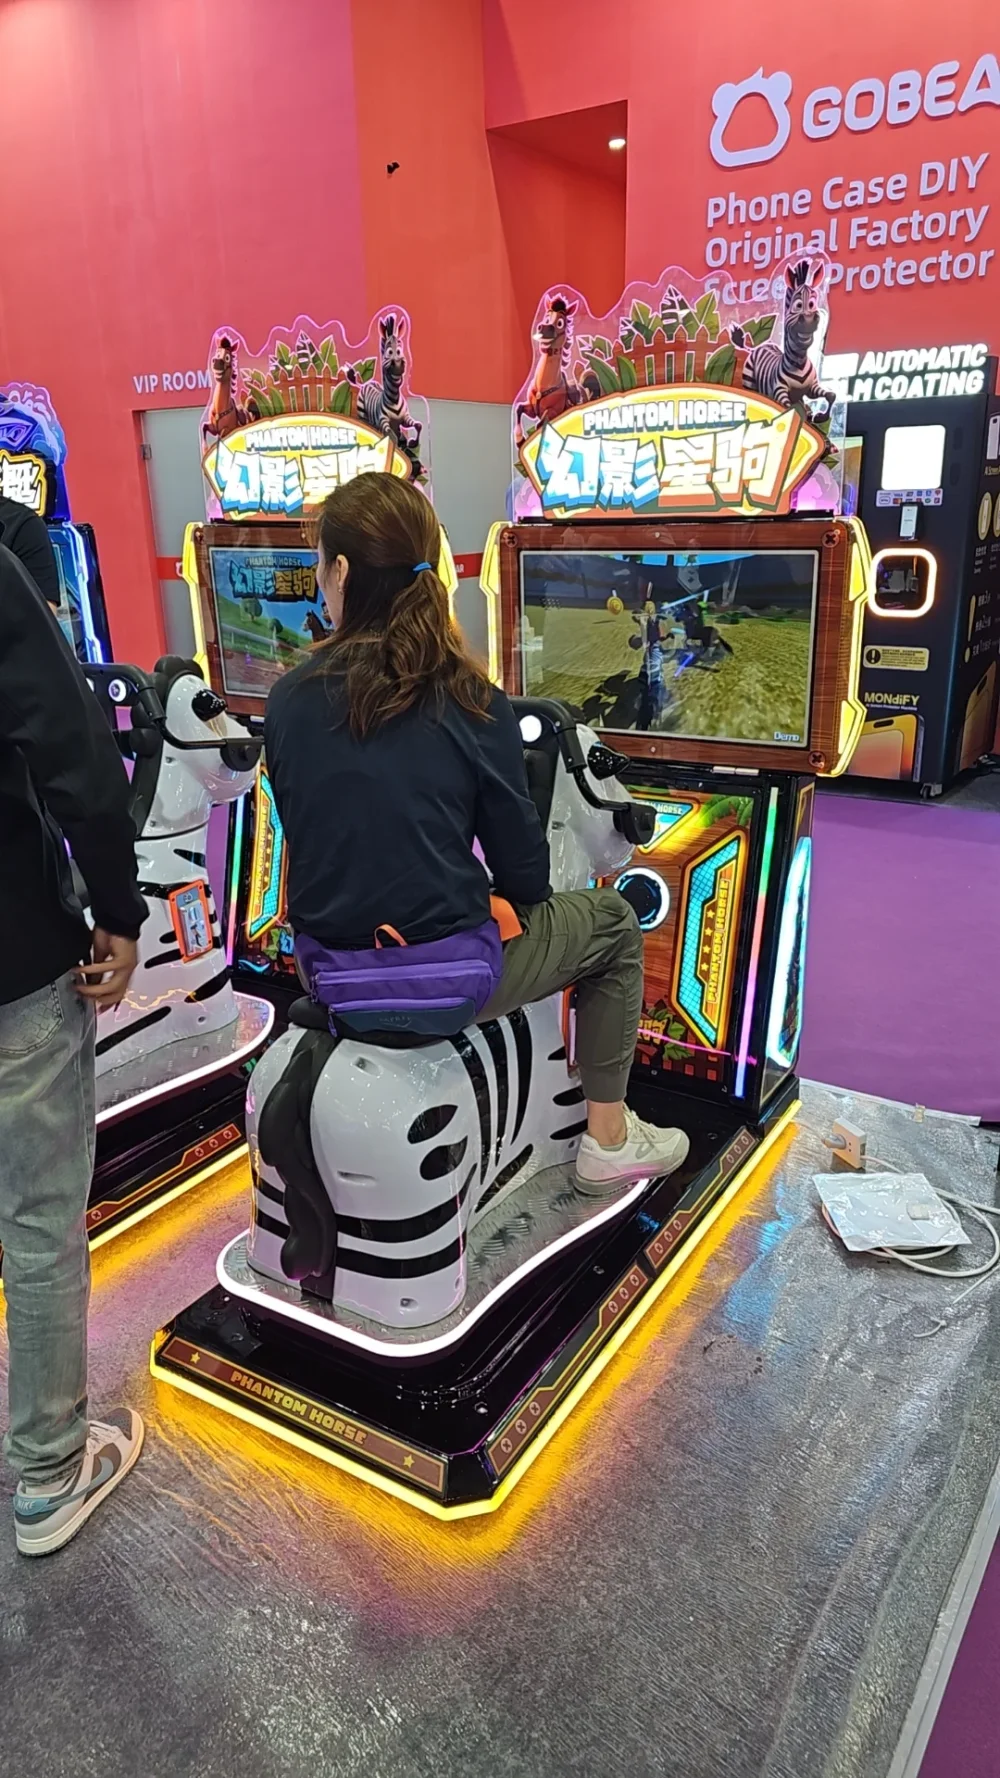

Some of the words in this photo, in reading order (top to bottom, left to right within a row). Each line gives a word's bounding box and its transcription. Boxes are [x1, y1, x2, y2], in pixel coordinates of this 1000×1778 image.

[706, 186, 812, 229] Phone
[822, 173, 907, 210] Case
[919, 152, 990, 197] DIY
[705, 218, 838, 270] Original
[849, 205, 990, 249] Factory
[705, 275, 785, 305] Scree
[825, 249, 996, 294] Protector
[858, 342, 988, 375] AUTOMATIC
[133, 374, 159, 394] VIP
[162, 369, 212, 392] ROOM
[875, 370, 985, 400] COATING
[583, 400, 675, 435] PHANTOM
[677, 400, 747, 430] HORSE
[245, 426, 306, 451] PHANTOM
[308, 425, 358, 449] HORSE
[536, 408, 798, 512] 幻影星驹
[864, 691, 920, 706] MONdiFY
[774, 731, 800, 741] Demo
[707, 930, 723, 1002] PHANTOM
[716, 879, 730, 929] HORSE
[230, 1370, 308, 1416] PHANTOM
[308, 1408, 368, 1446] HORSE
